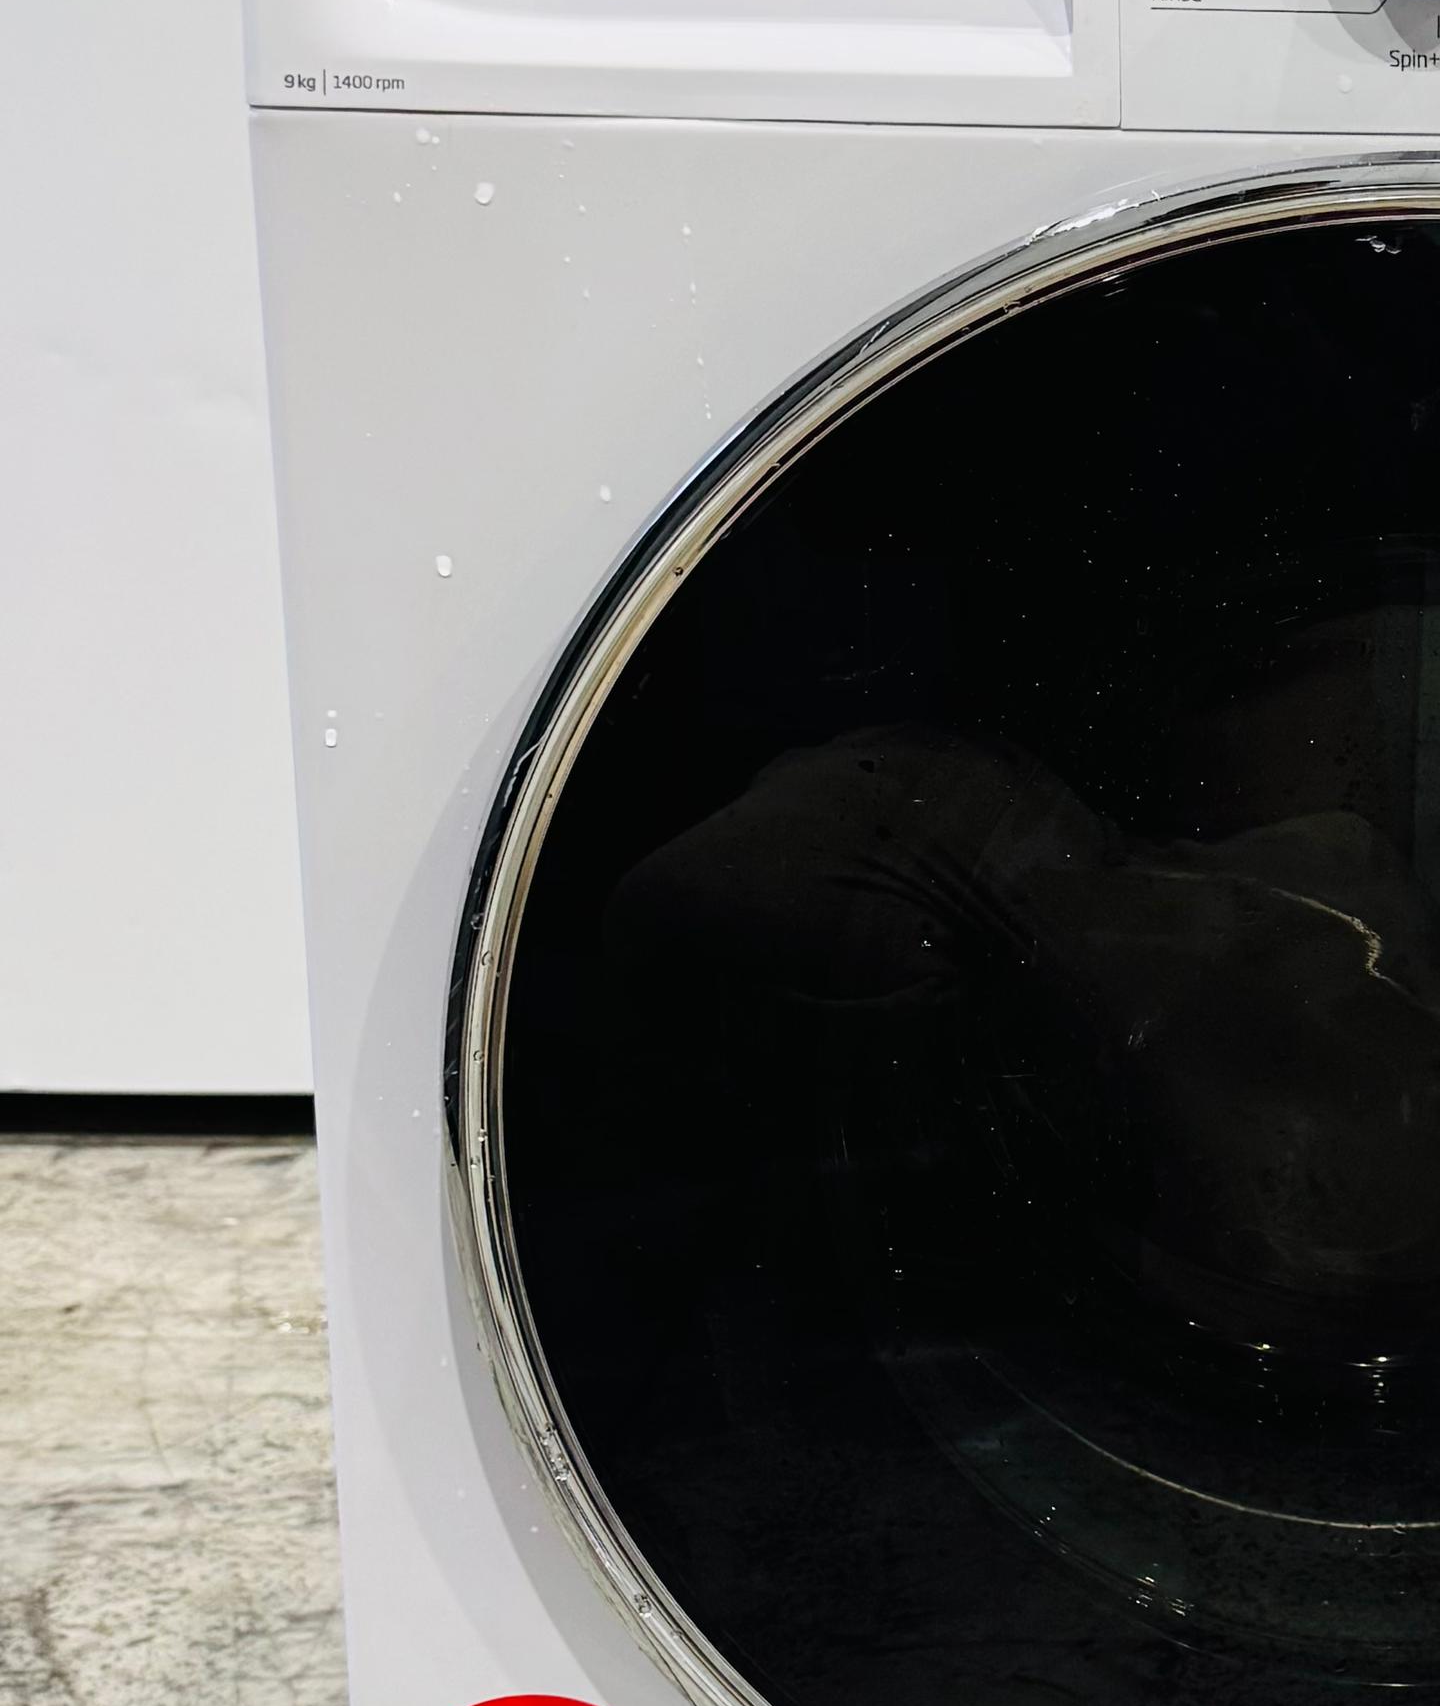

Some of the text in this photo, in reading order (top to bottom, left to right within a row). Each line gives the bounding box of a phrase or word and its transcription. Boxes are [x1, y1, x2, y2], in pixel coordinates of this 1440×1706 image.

[284, 74, 405, 92] 9 kg 1400 rpm
